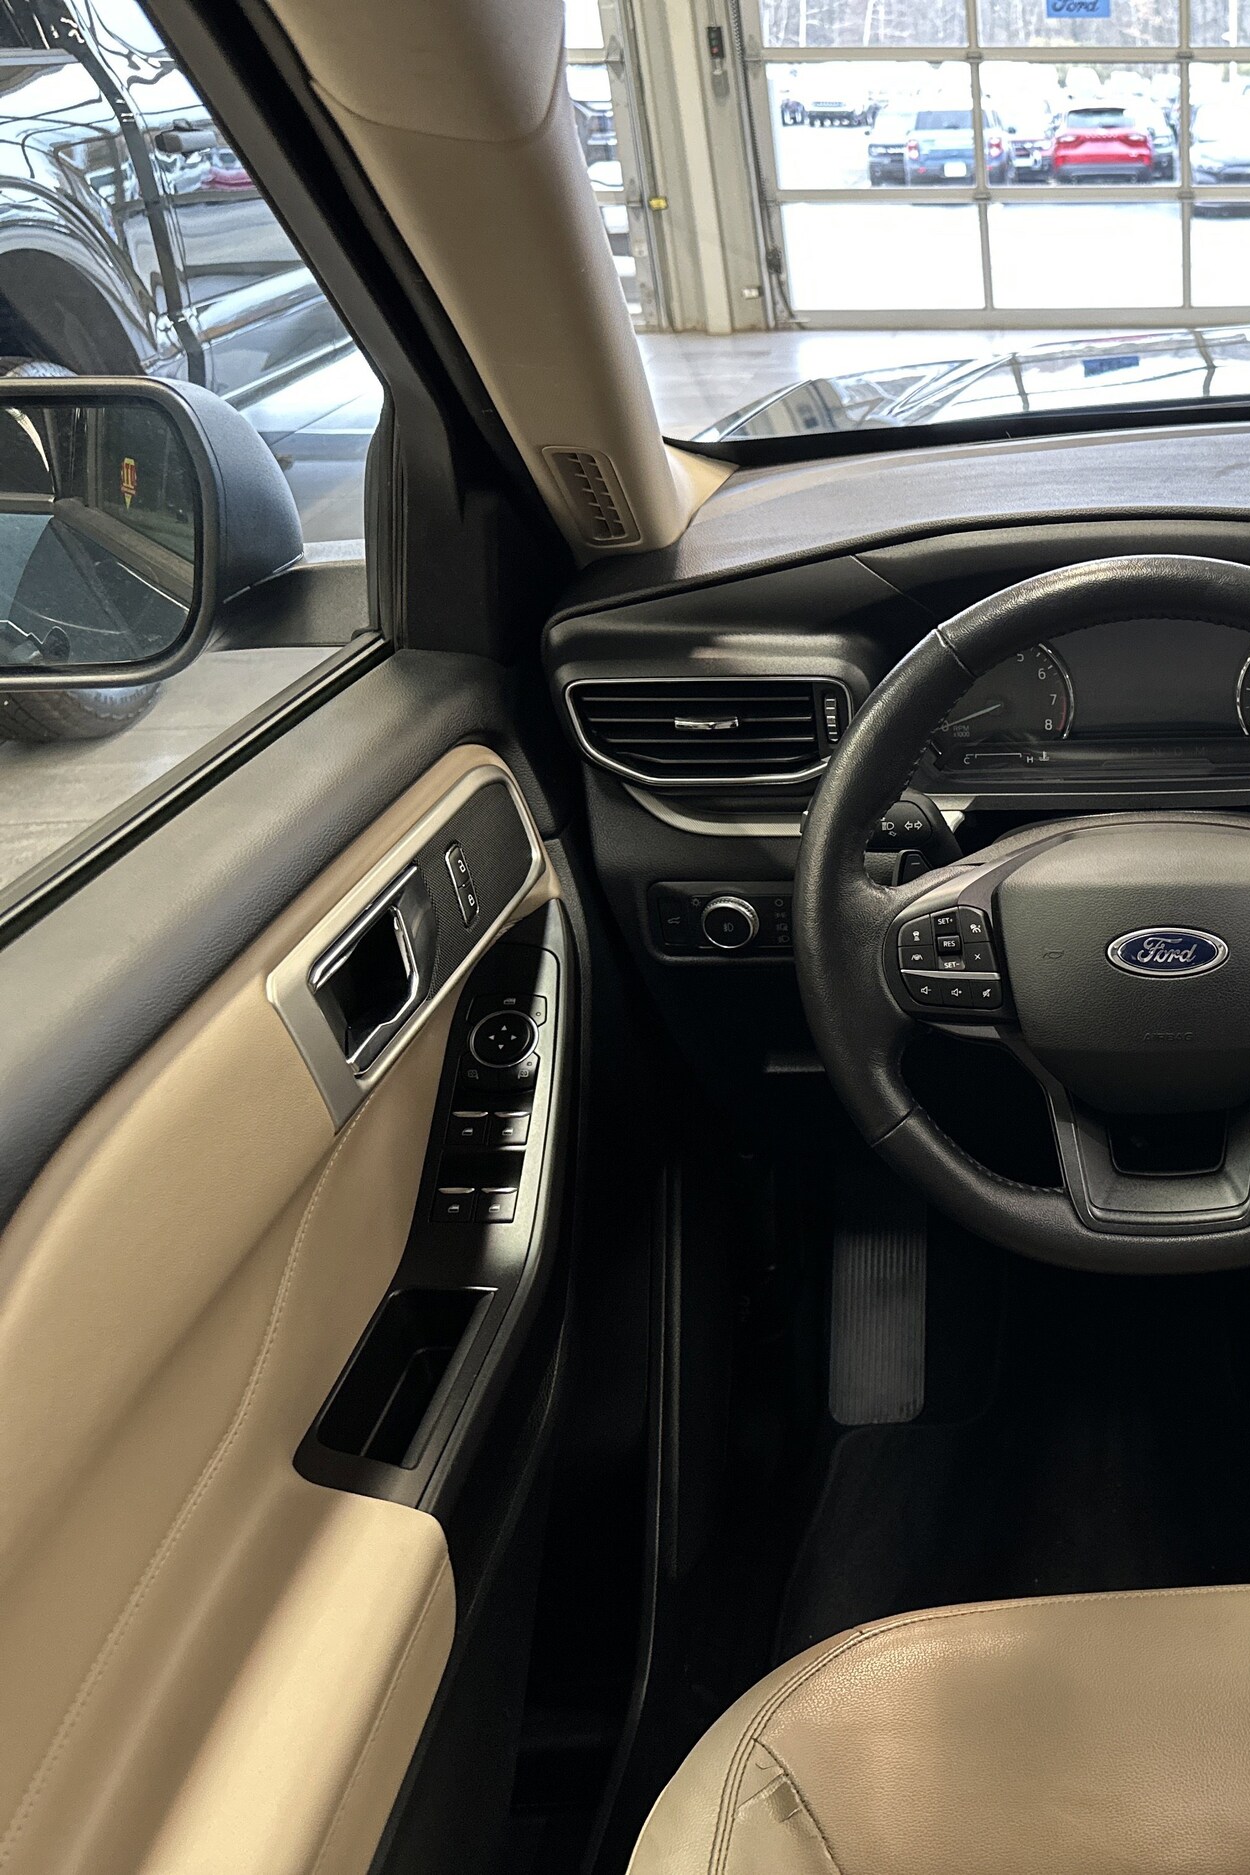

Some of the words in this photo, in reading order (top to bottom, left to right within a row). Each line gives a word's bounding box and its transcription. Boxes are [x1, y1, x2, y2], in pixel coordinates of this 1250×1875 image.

[1037, 667, 1046, 680] 6
[1049, 693, 1058, 706] 7
[1044, 718, 1053, 731] 8
[1026, 755, 1034, 763] H
[1137, 937, 1197, 963] Ford
